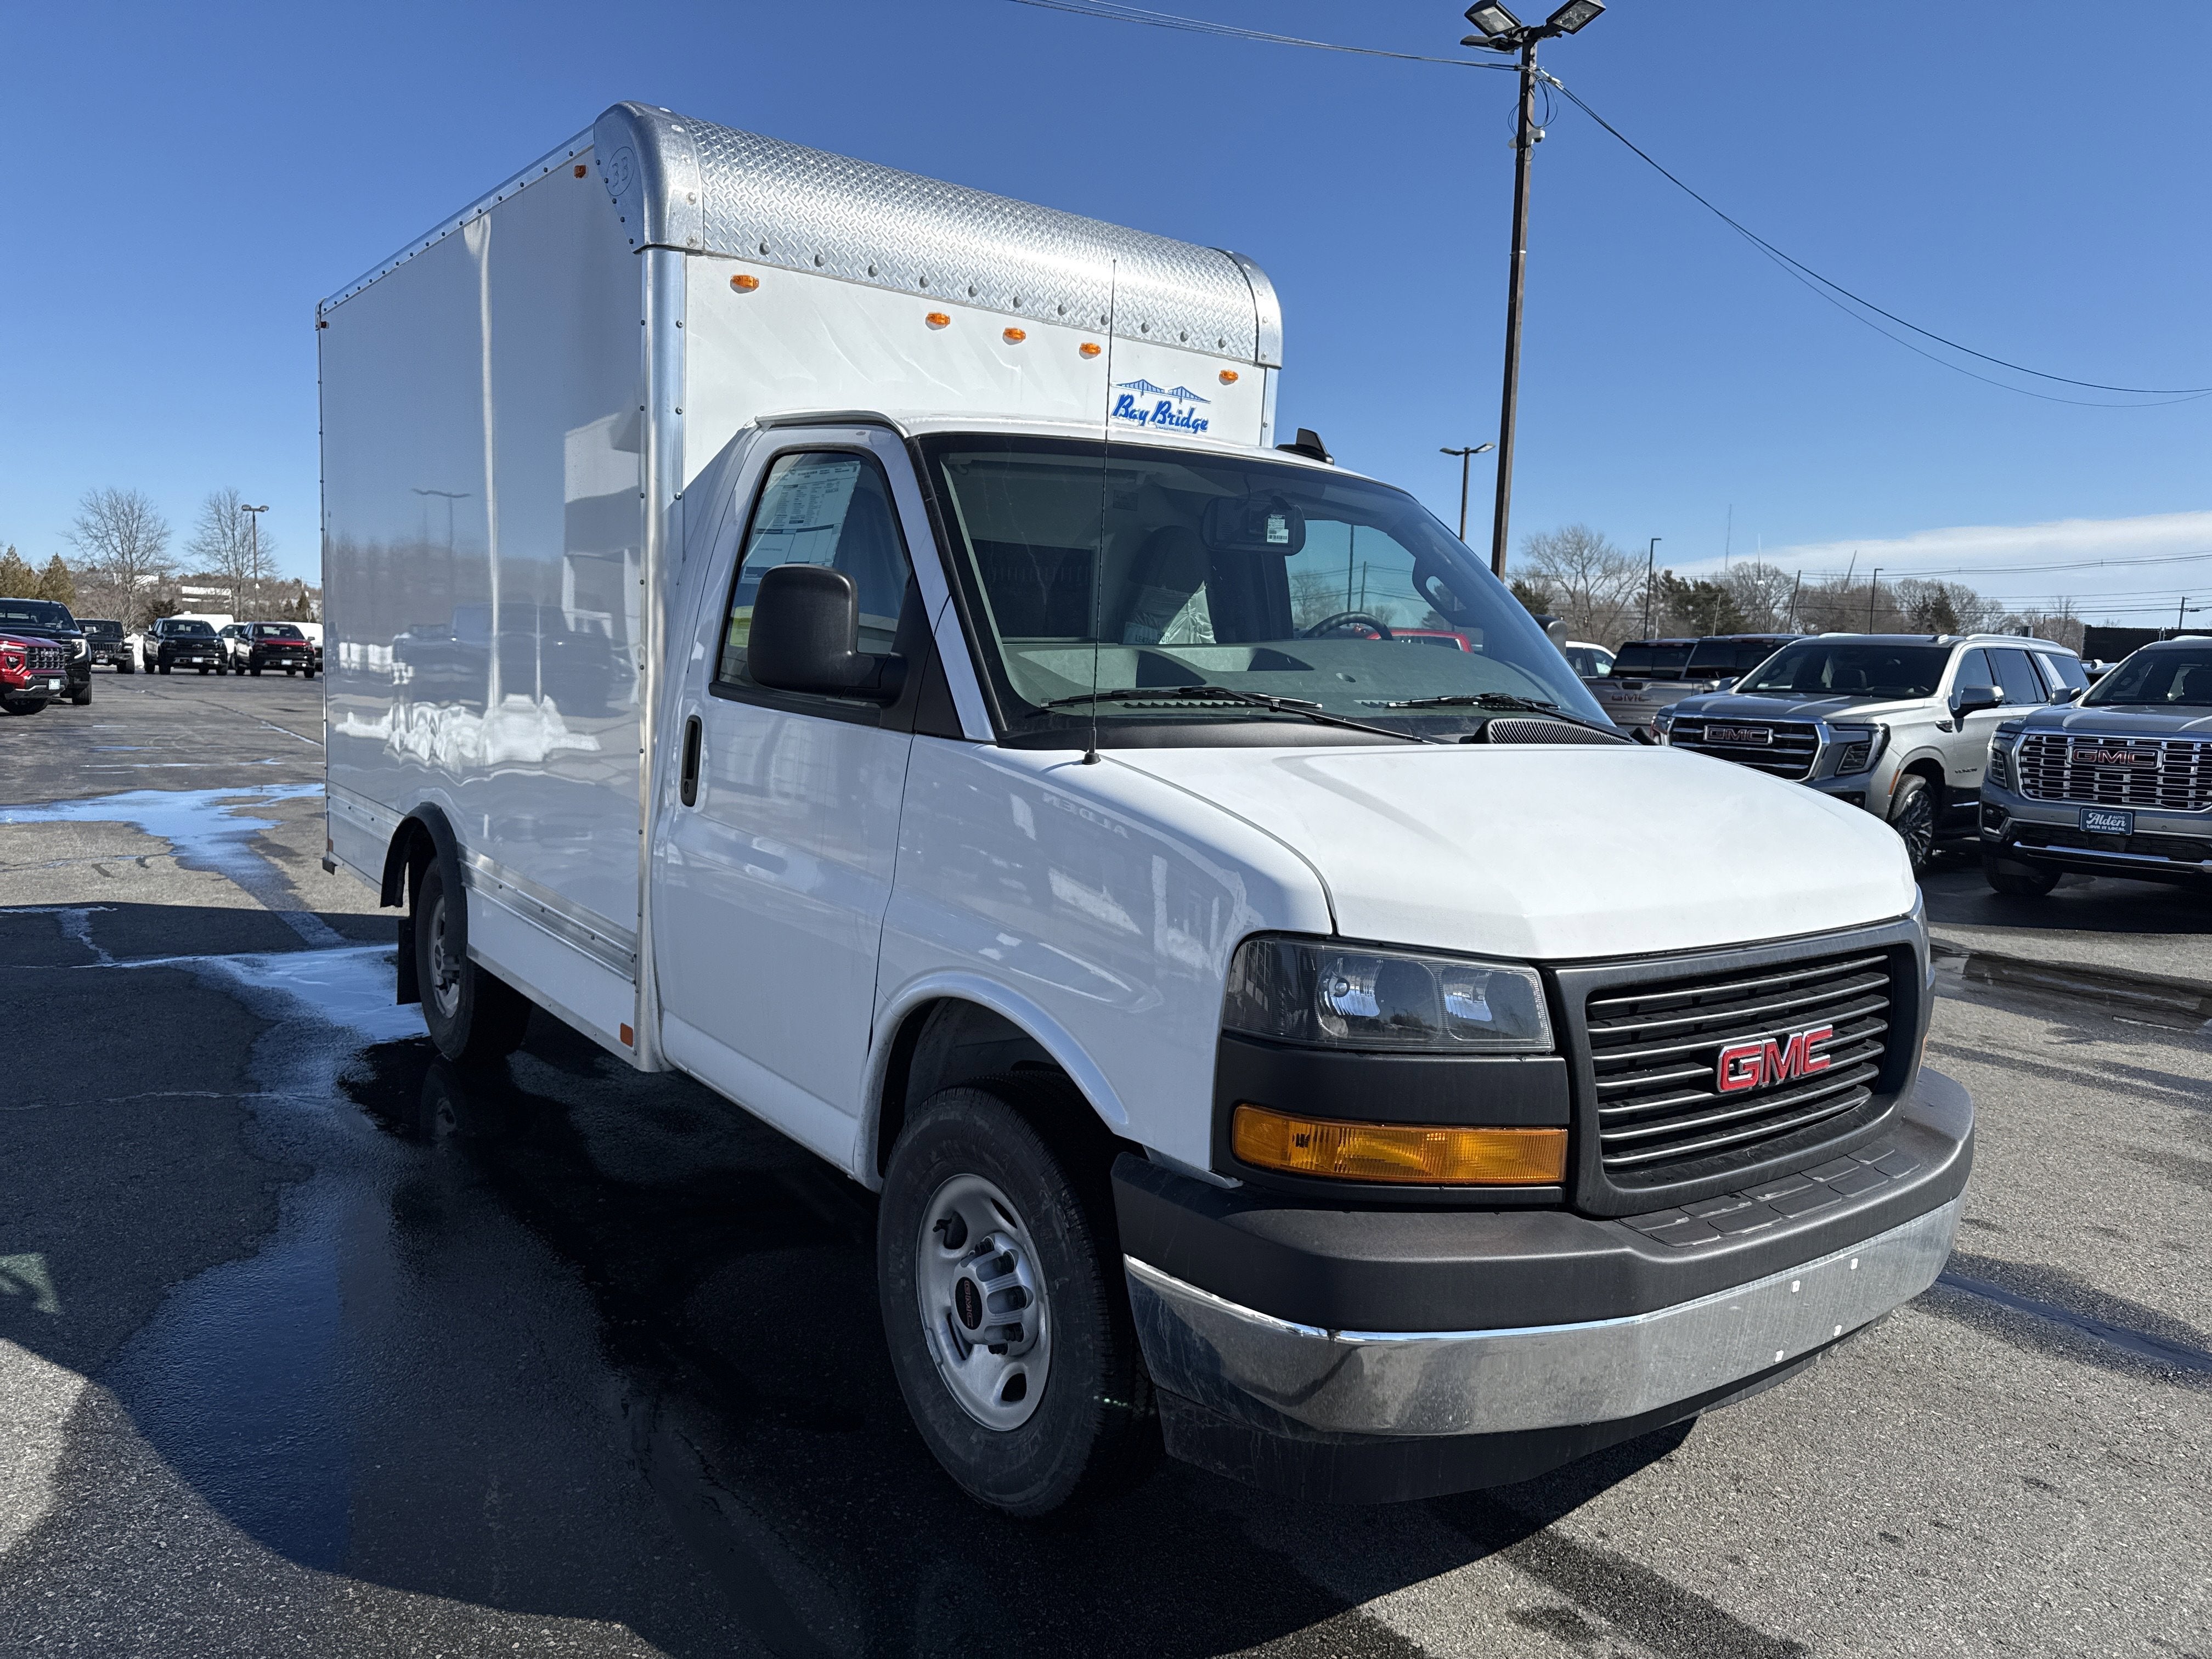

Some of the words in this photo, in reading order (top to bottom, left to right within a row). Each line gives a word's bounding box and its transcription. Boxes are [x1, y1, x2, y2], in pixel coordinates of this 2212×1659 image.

[1111, 393, 1150, 426] Bay
[1150, 400, 1209, 434] Bridge
[1708, 727, 1767, 742] GMC
[2073, 749, 2155, 767] GMC
[2086, 812, 2126, 827] Alden
[1717, 1024, 1833, 1093] GMC
[964, 1280, 974, 1327] GMC
